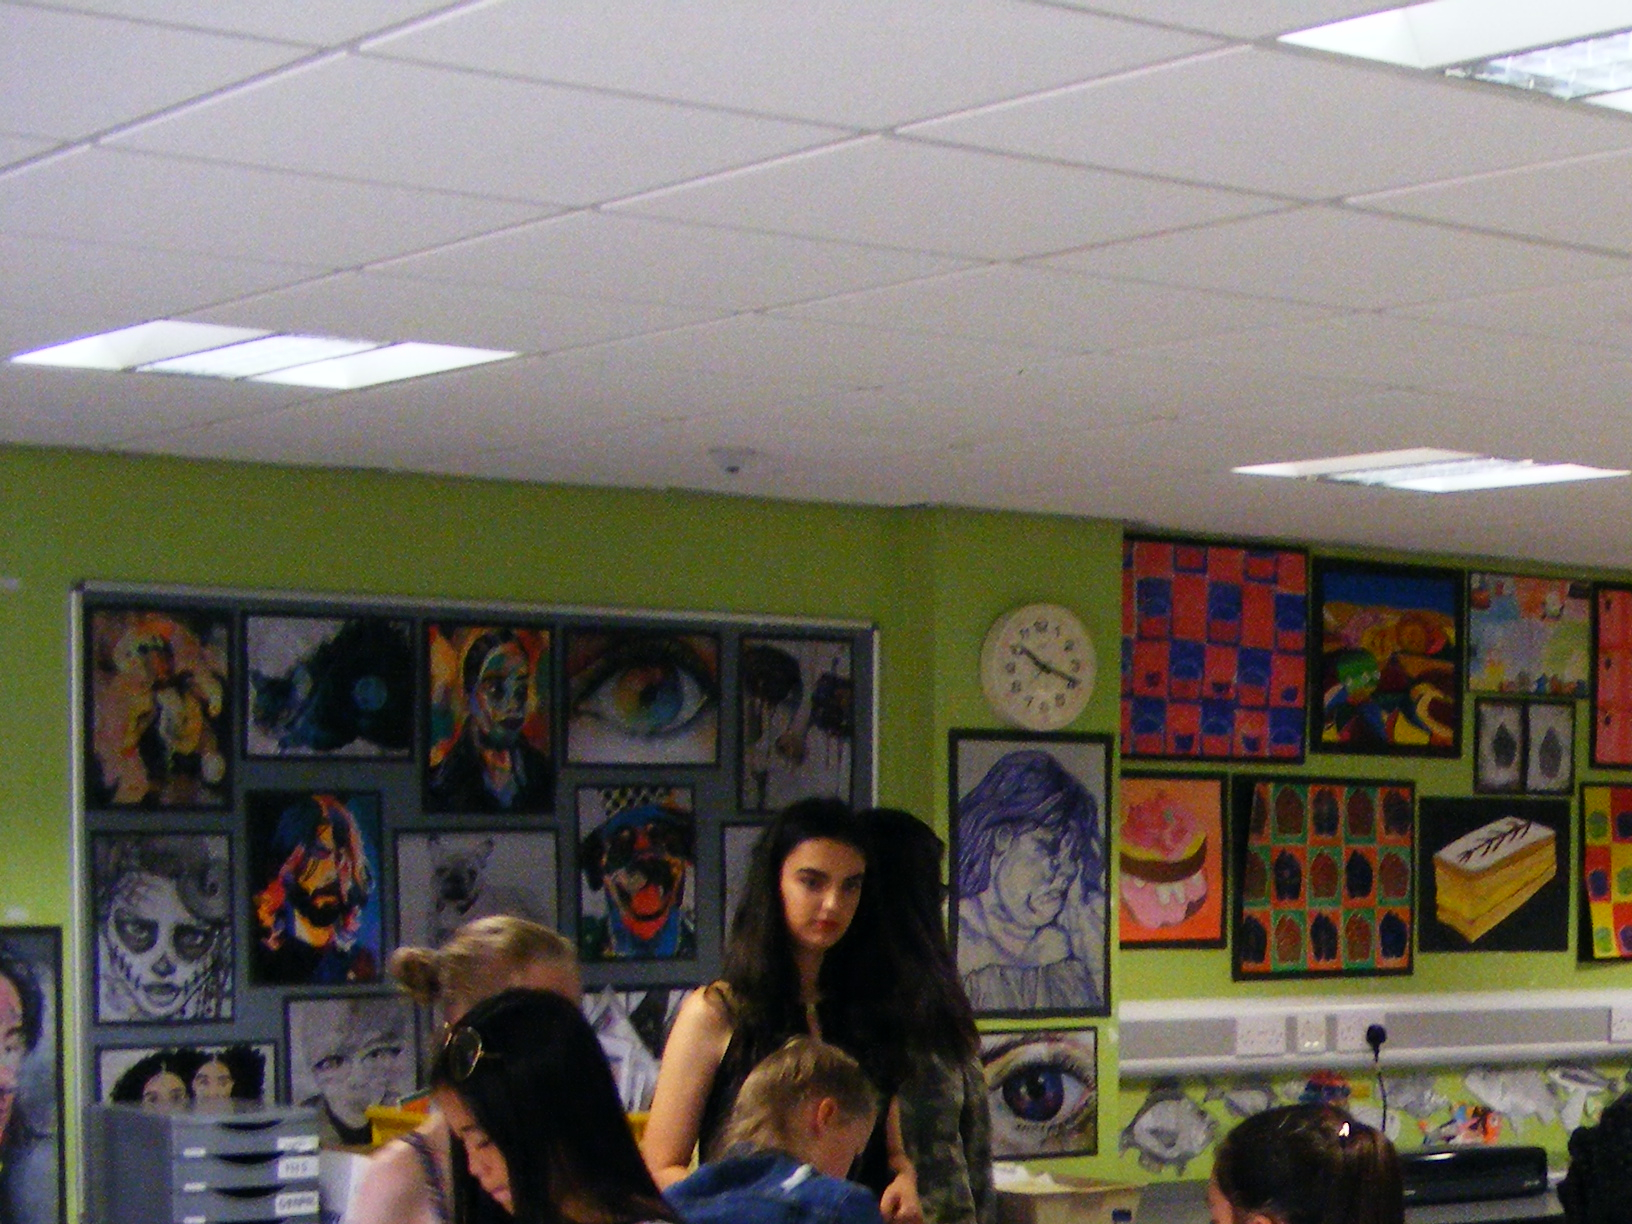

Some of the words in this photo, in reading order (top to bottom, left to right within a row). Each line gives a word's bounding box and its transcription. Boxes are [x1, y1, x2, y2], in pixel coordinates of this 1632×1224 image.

[1019, 627, 1030, 639] 11
[1063, 639, 1075, 652] 2
[1070, 658, 1082, 673] 3
